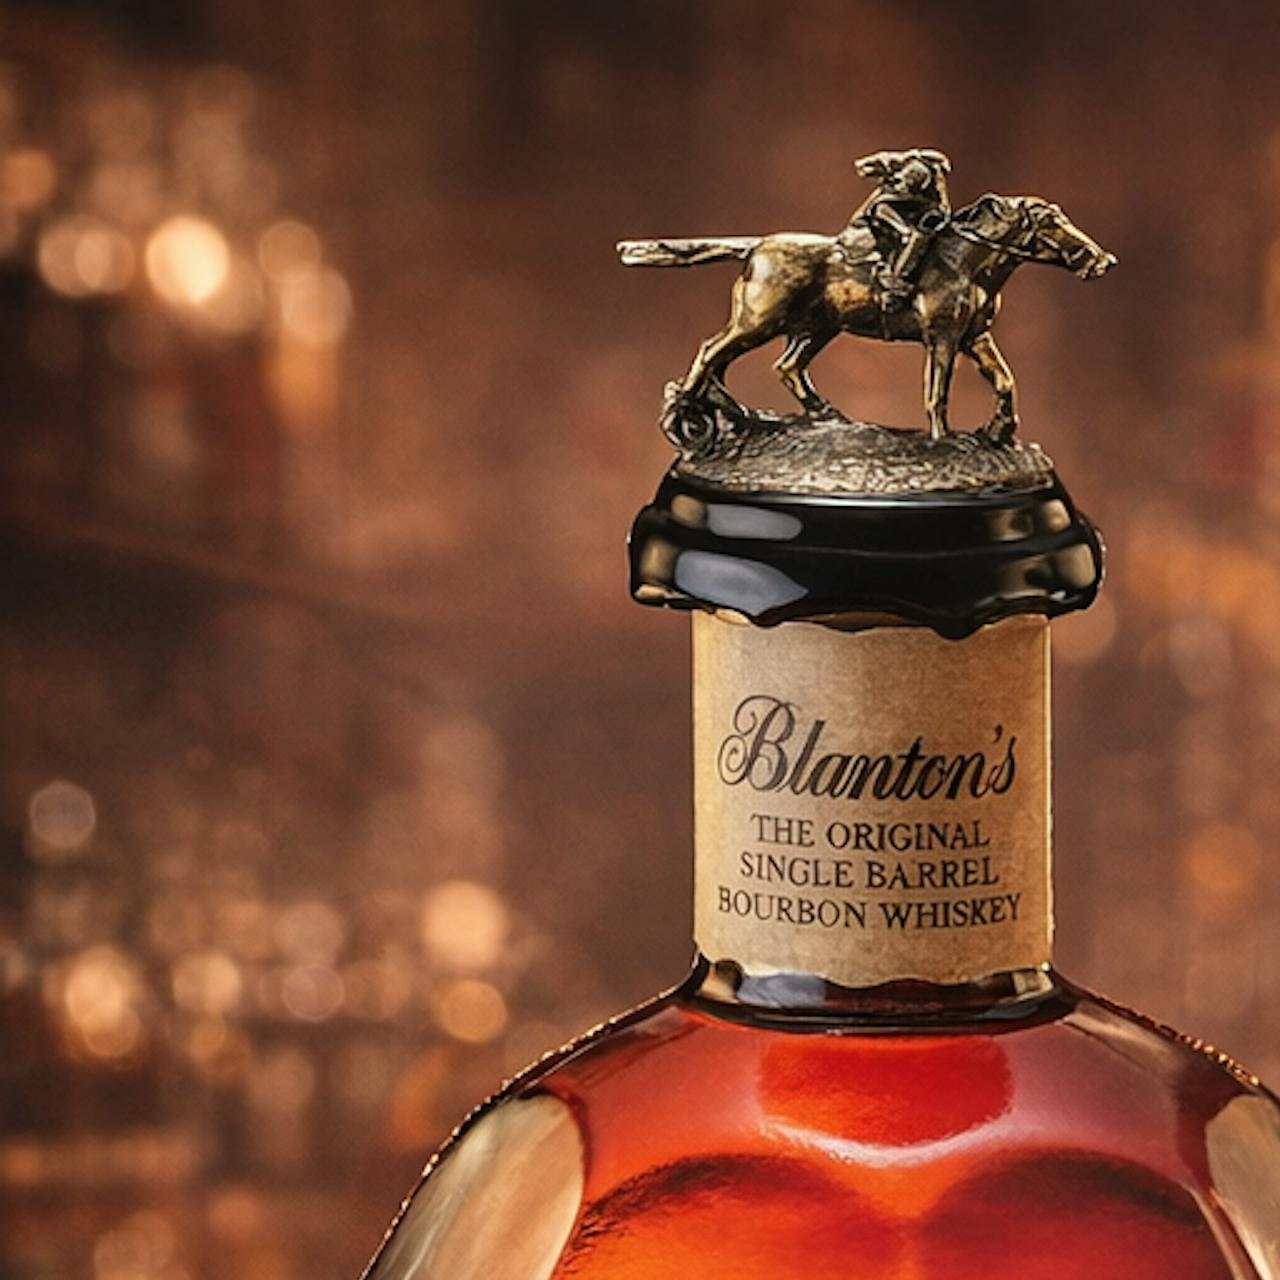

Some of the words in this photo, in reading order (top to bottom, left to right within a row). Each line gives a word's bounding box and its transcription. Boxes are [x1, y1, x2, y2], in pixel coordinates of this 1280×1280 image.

[718, 695, 1018, 800] Blanton's
[750, 814, 814, 848] THE
[827, 821, 991, 851] ORIGINAL
[740, 852, 854, 889] SINGLE
[865, 857, 999, 890] BARREL
[718, 886, 867, 928] BOURBON
[880, 893, 1021, 929] WHISKEY
